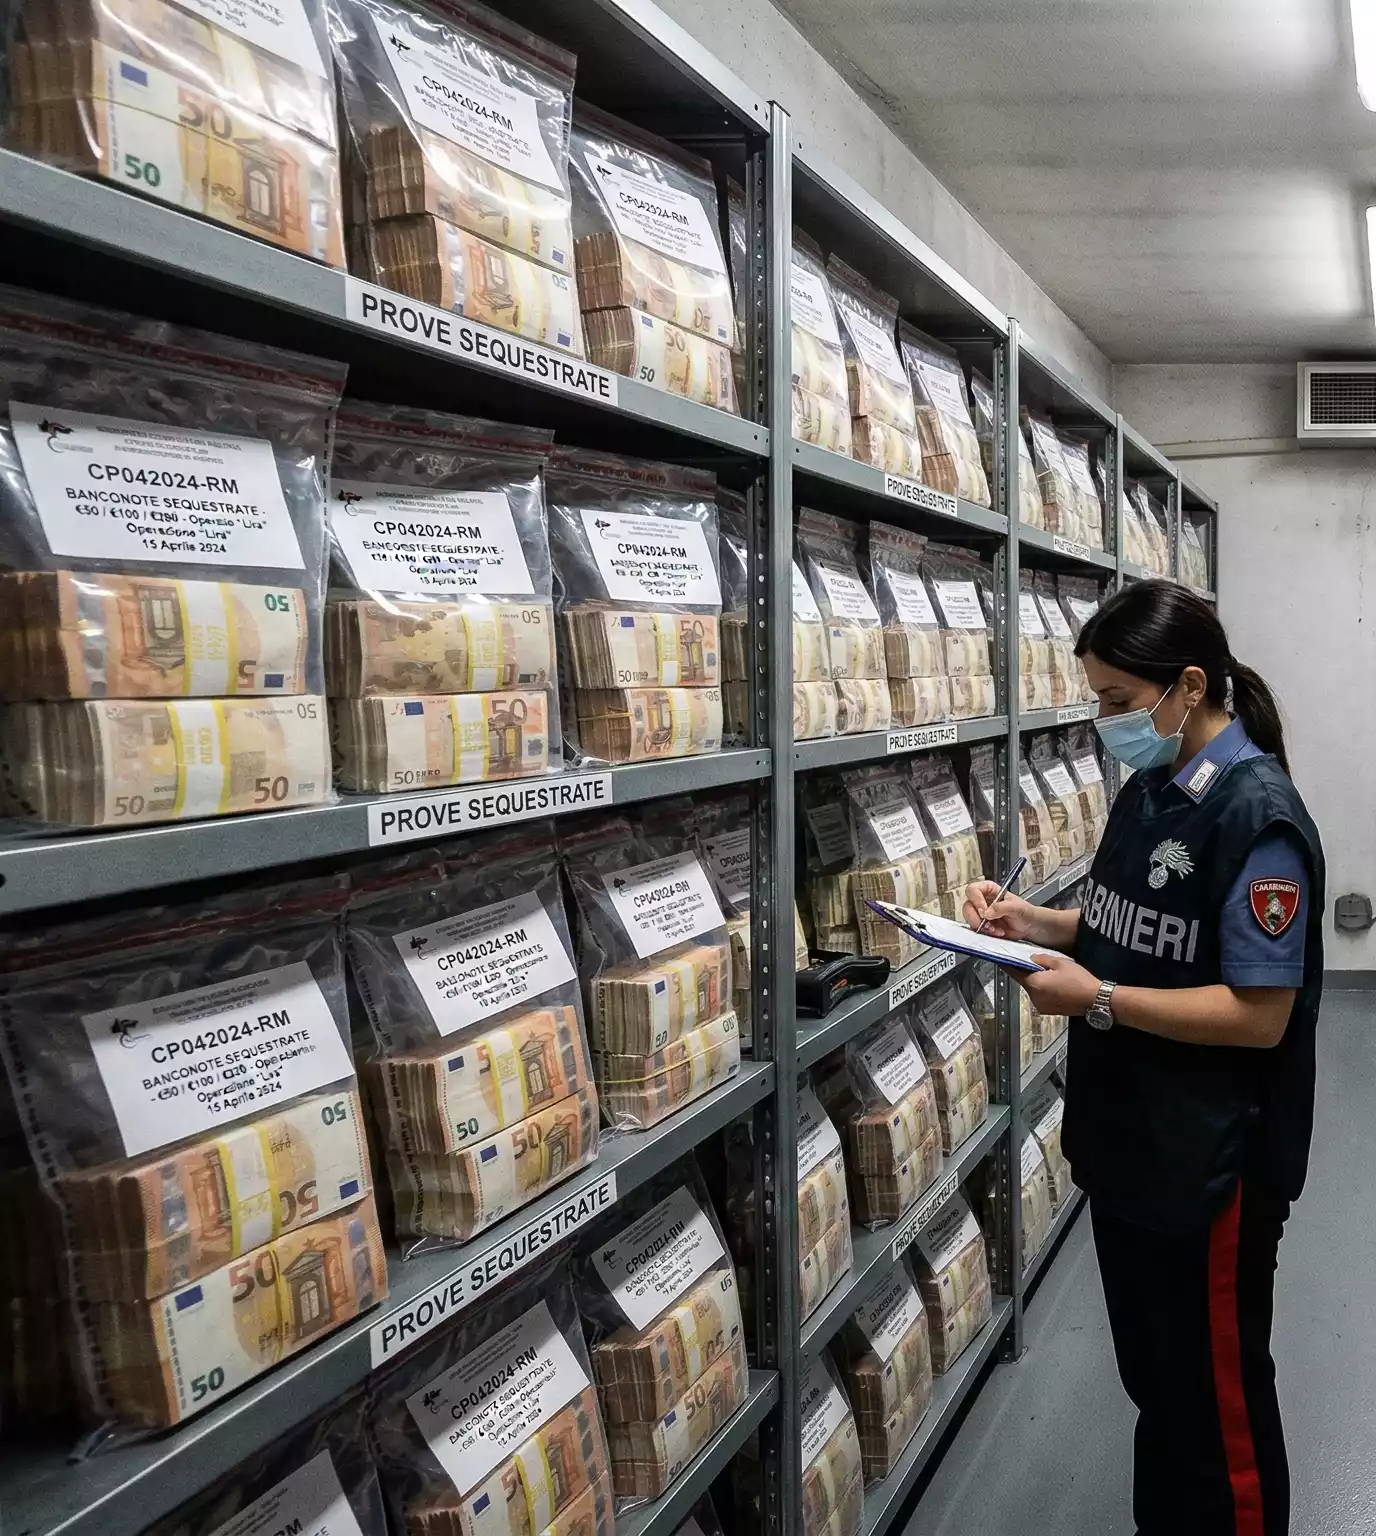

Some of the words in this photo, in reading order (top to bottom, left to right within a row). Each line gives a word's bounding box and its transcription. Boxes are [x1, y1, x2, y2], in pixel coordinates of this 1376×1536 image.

[124, 153, 161, 187] 50
[361, 292, 451, 344] PROVE
[460, 327, 610, 398] SEQUESTRATE
[665, 326, 686, 352] 50
[639, 365, 656, 383] 50
[87, 462, 240, 494] CP042024-RM
[65, 487, 159, 508] BANCONOTE
[163, 497, 259, 517] SEQUESTRATE
[373, 521, 482, 540] CP042024-RM
[521, 610, 541, 625] 50
[680, 619, 704, 638] 50
[618, 669, 632, 684] 50
[297, 703, 318, 719] 50
[491, 698, 529, 720] 50
[254, 776, 290, 804] 50
[394, 771, 414, 786] 50
[114, 795, 146, 817] 50
[380, 802, 461, 836] PROVE
[468, 780, 605, 821] SEQUESTRATE
[437, 928, 528, 973] CP042024-RM
[151, 1010, 291, 1064] CP042024-RM
[142, 1058, 224, 1091] BANCONOTE
[225, 1030, 310, 1065] SEQUESTRATE
[321, 1099, 347, 1127] 50
[457, 1117, 480, 1141] 50
[511, 1121, 543, 1160] 50
[279, 1179, 319, 1228] 50
[228, 1251, 279, 1304] 50
[381, 1278, 465, 1354] PROVE
[470, 1182, 611, 1291] SEQUESTRATE
[190, 1366, 225, 1402] 50
